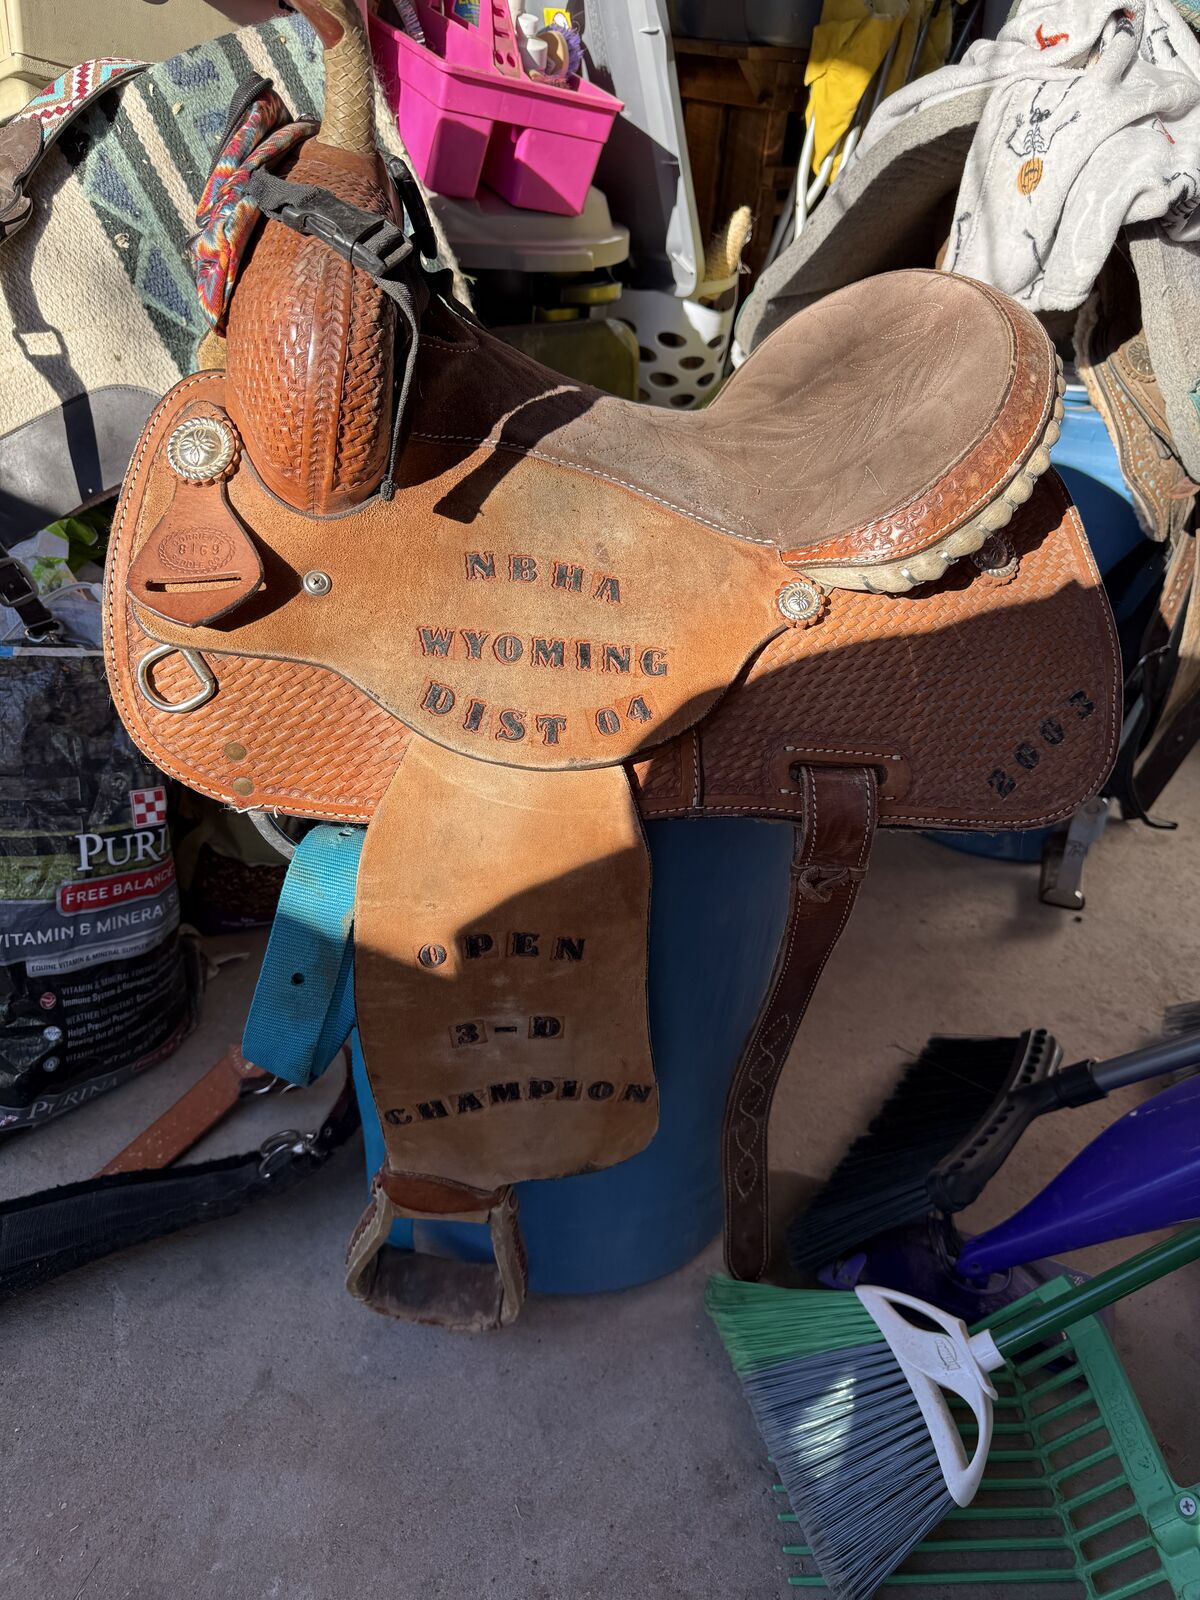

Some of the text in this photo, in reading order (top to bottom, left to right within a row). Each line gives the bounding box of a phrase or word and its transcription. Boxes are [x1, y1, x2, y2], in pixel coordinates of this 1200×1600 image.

[178, 543, 220, 556] 8169
[465, 551, 622, 604] NBHA
[417, 626, 669, 678] WYOMING
[420, 680, 653, 746] DIST 04
[986, 689, 1096, 800] 2003
[75, 828, 168, 871] PURI
[66, 864, 175, 905] FREE BALANCE
[80, 923, 91, 936] &
[417, 931, 587, 969] OPEN
[59, 957, 84, 969] VITAMIN
[456, 1016, 562, 1046] 3-D
[384, 1080, 653, 1127] CHAMPION
